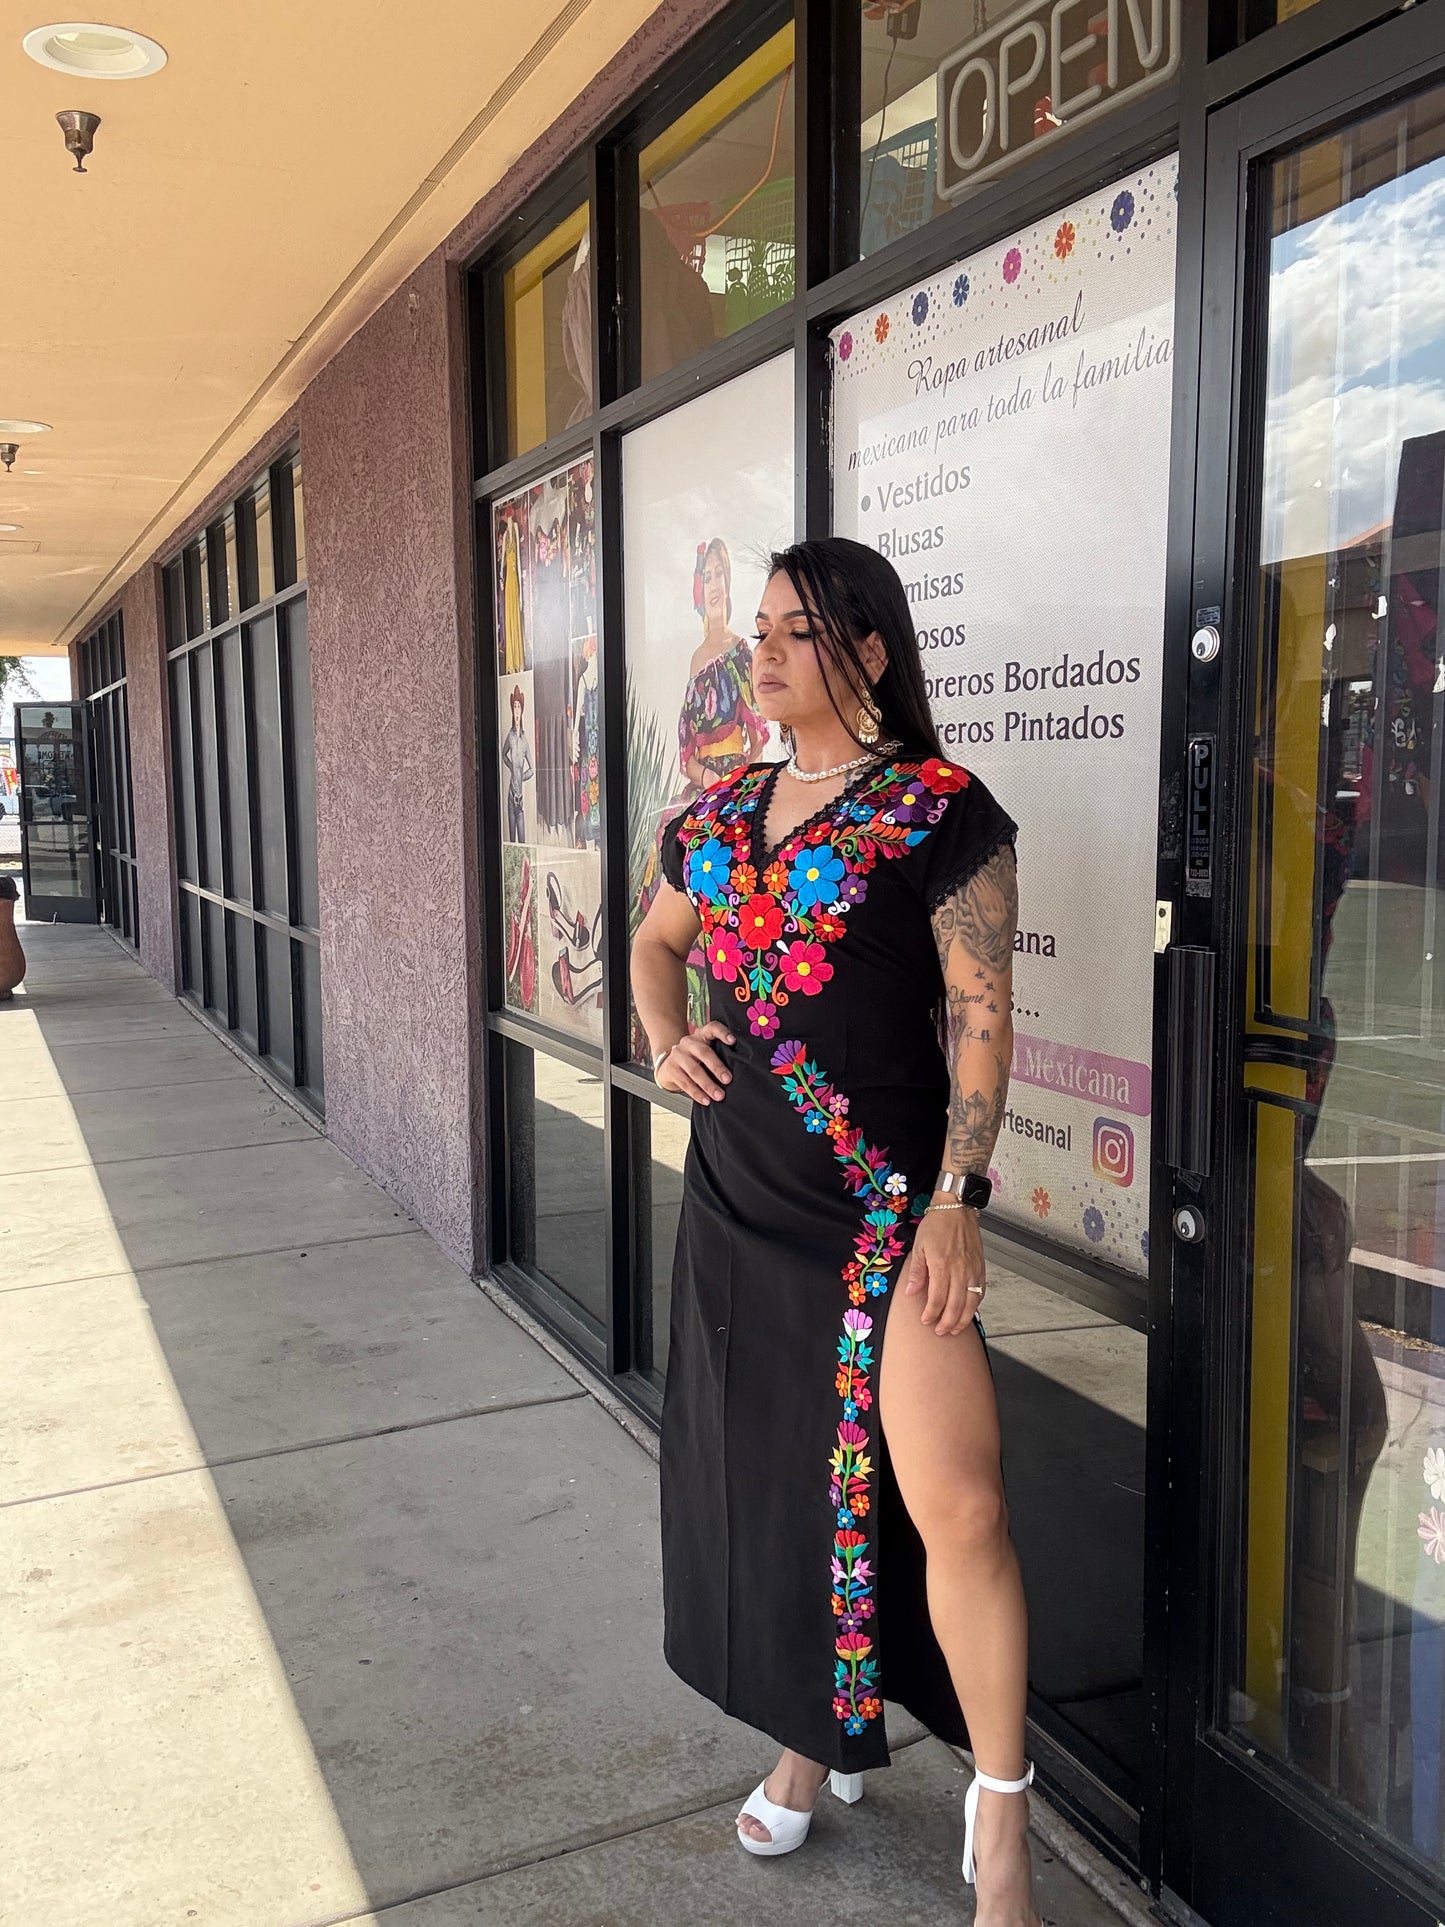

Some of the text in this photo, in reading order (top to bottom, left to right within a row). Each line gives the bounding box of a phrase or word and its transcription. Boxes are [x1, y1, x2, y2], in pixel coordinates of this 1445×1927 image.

[950, 0, 1163, 170] OPEN
[907, 289, 1086, 398] Ropa artesanal
[847, 325, 1174, 472] mexicana para toda la familia
[877, 463, 971, 512] Vestidos
[877, 526, 944, 559] Blusas
[904, 572, 964, 603] misas
[916, 624, 966, 651] osos
[923, 649, 1141, 700] breros Bordados
[934, 704, 1125, 744] reros Pintados
[1193, 744, 1209, 836] PULL
[1013, 930, 1057, 958] ana
[1024, 1046, 1131, 1105] Mexicana
[1002, 1108, 1072, 1151] rtesanal
